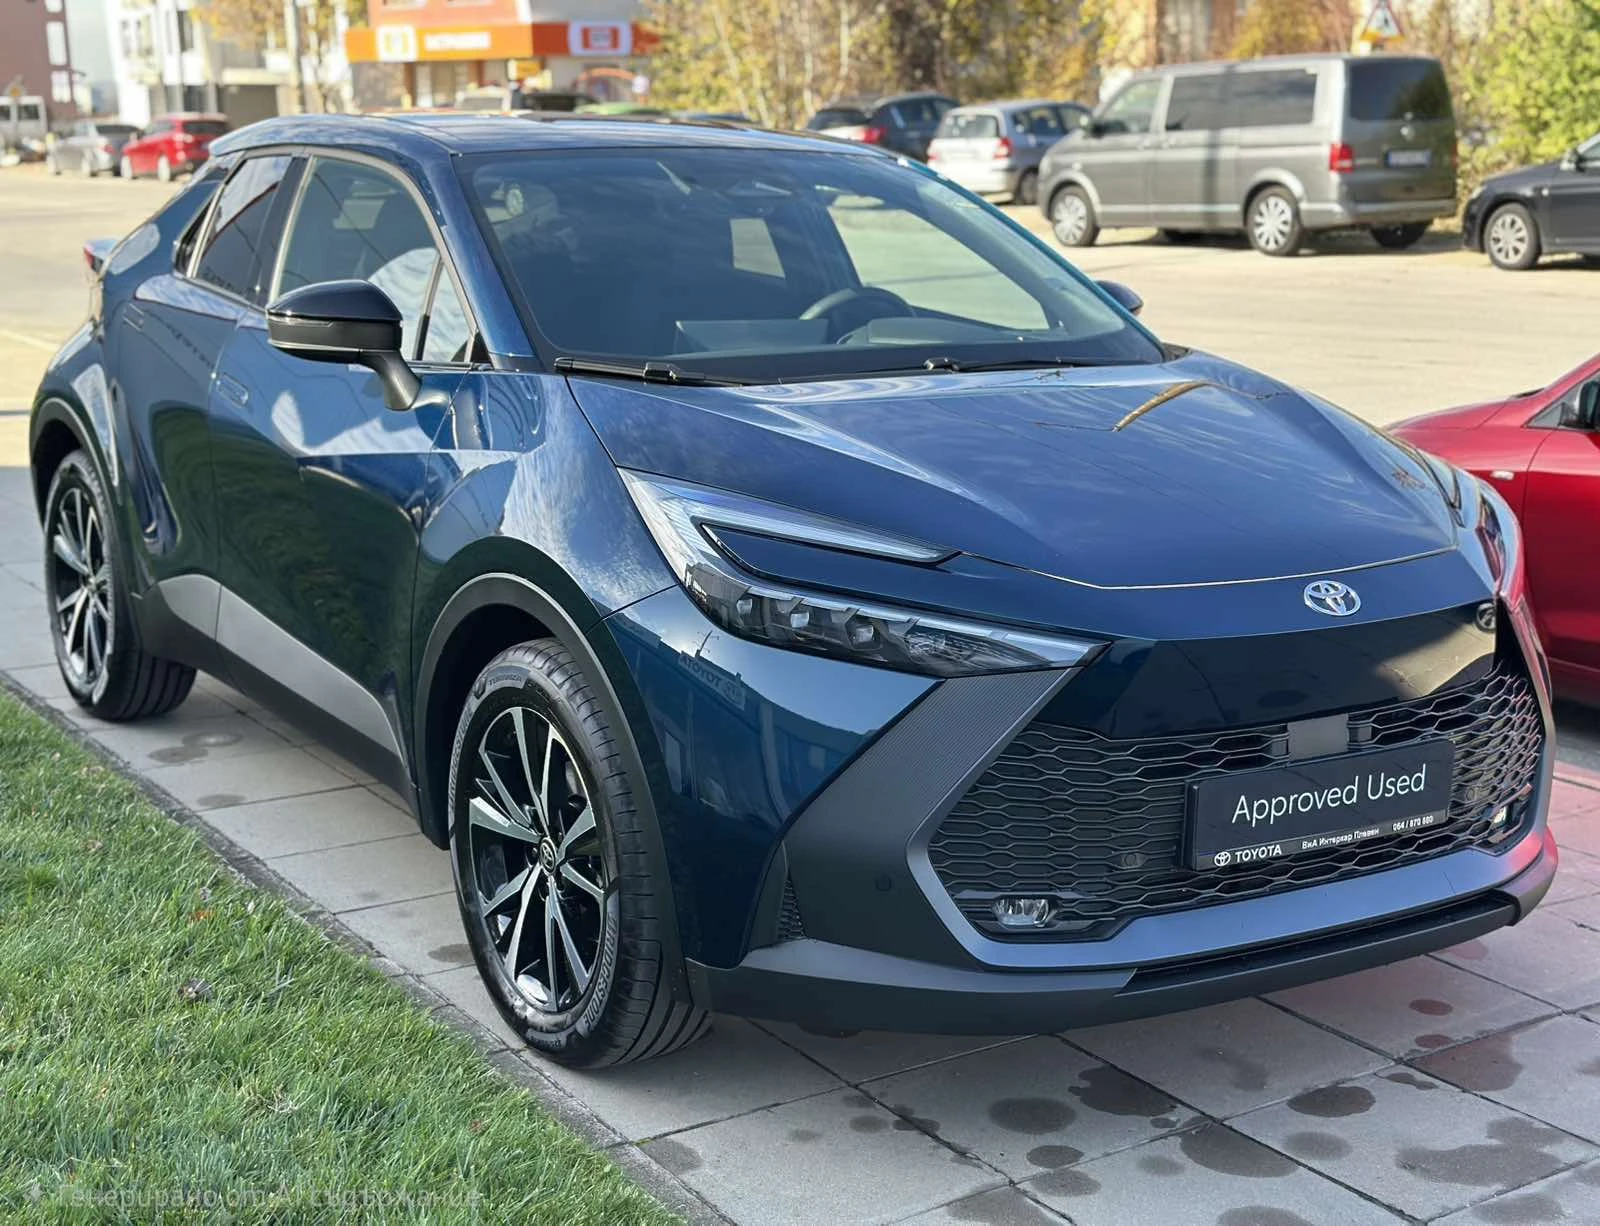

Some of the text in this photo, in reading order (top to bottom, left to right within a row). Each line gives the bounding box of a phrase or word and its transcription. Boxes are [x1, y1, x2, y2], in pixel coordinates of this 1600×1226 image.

[1232, 763, 1427, 826] Approved Used
[1235, 844, 1282, 863] TOYOTA
[584, 913, 617, 1029] BRIDGESTONE
